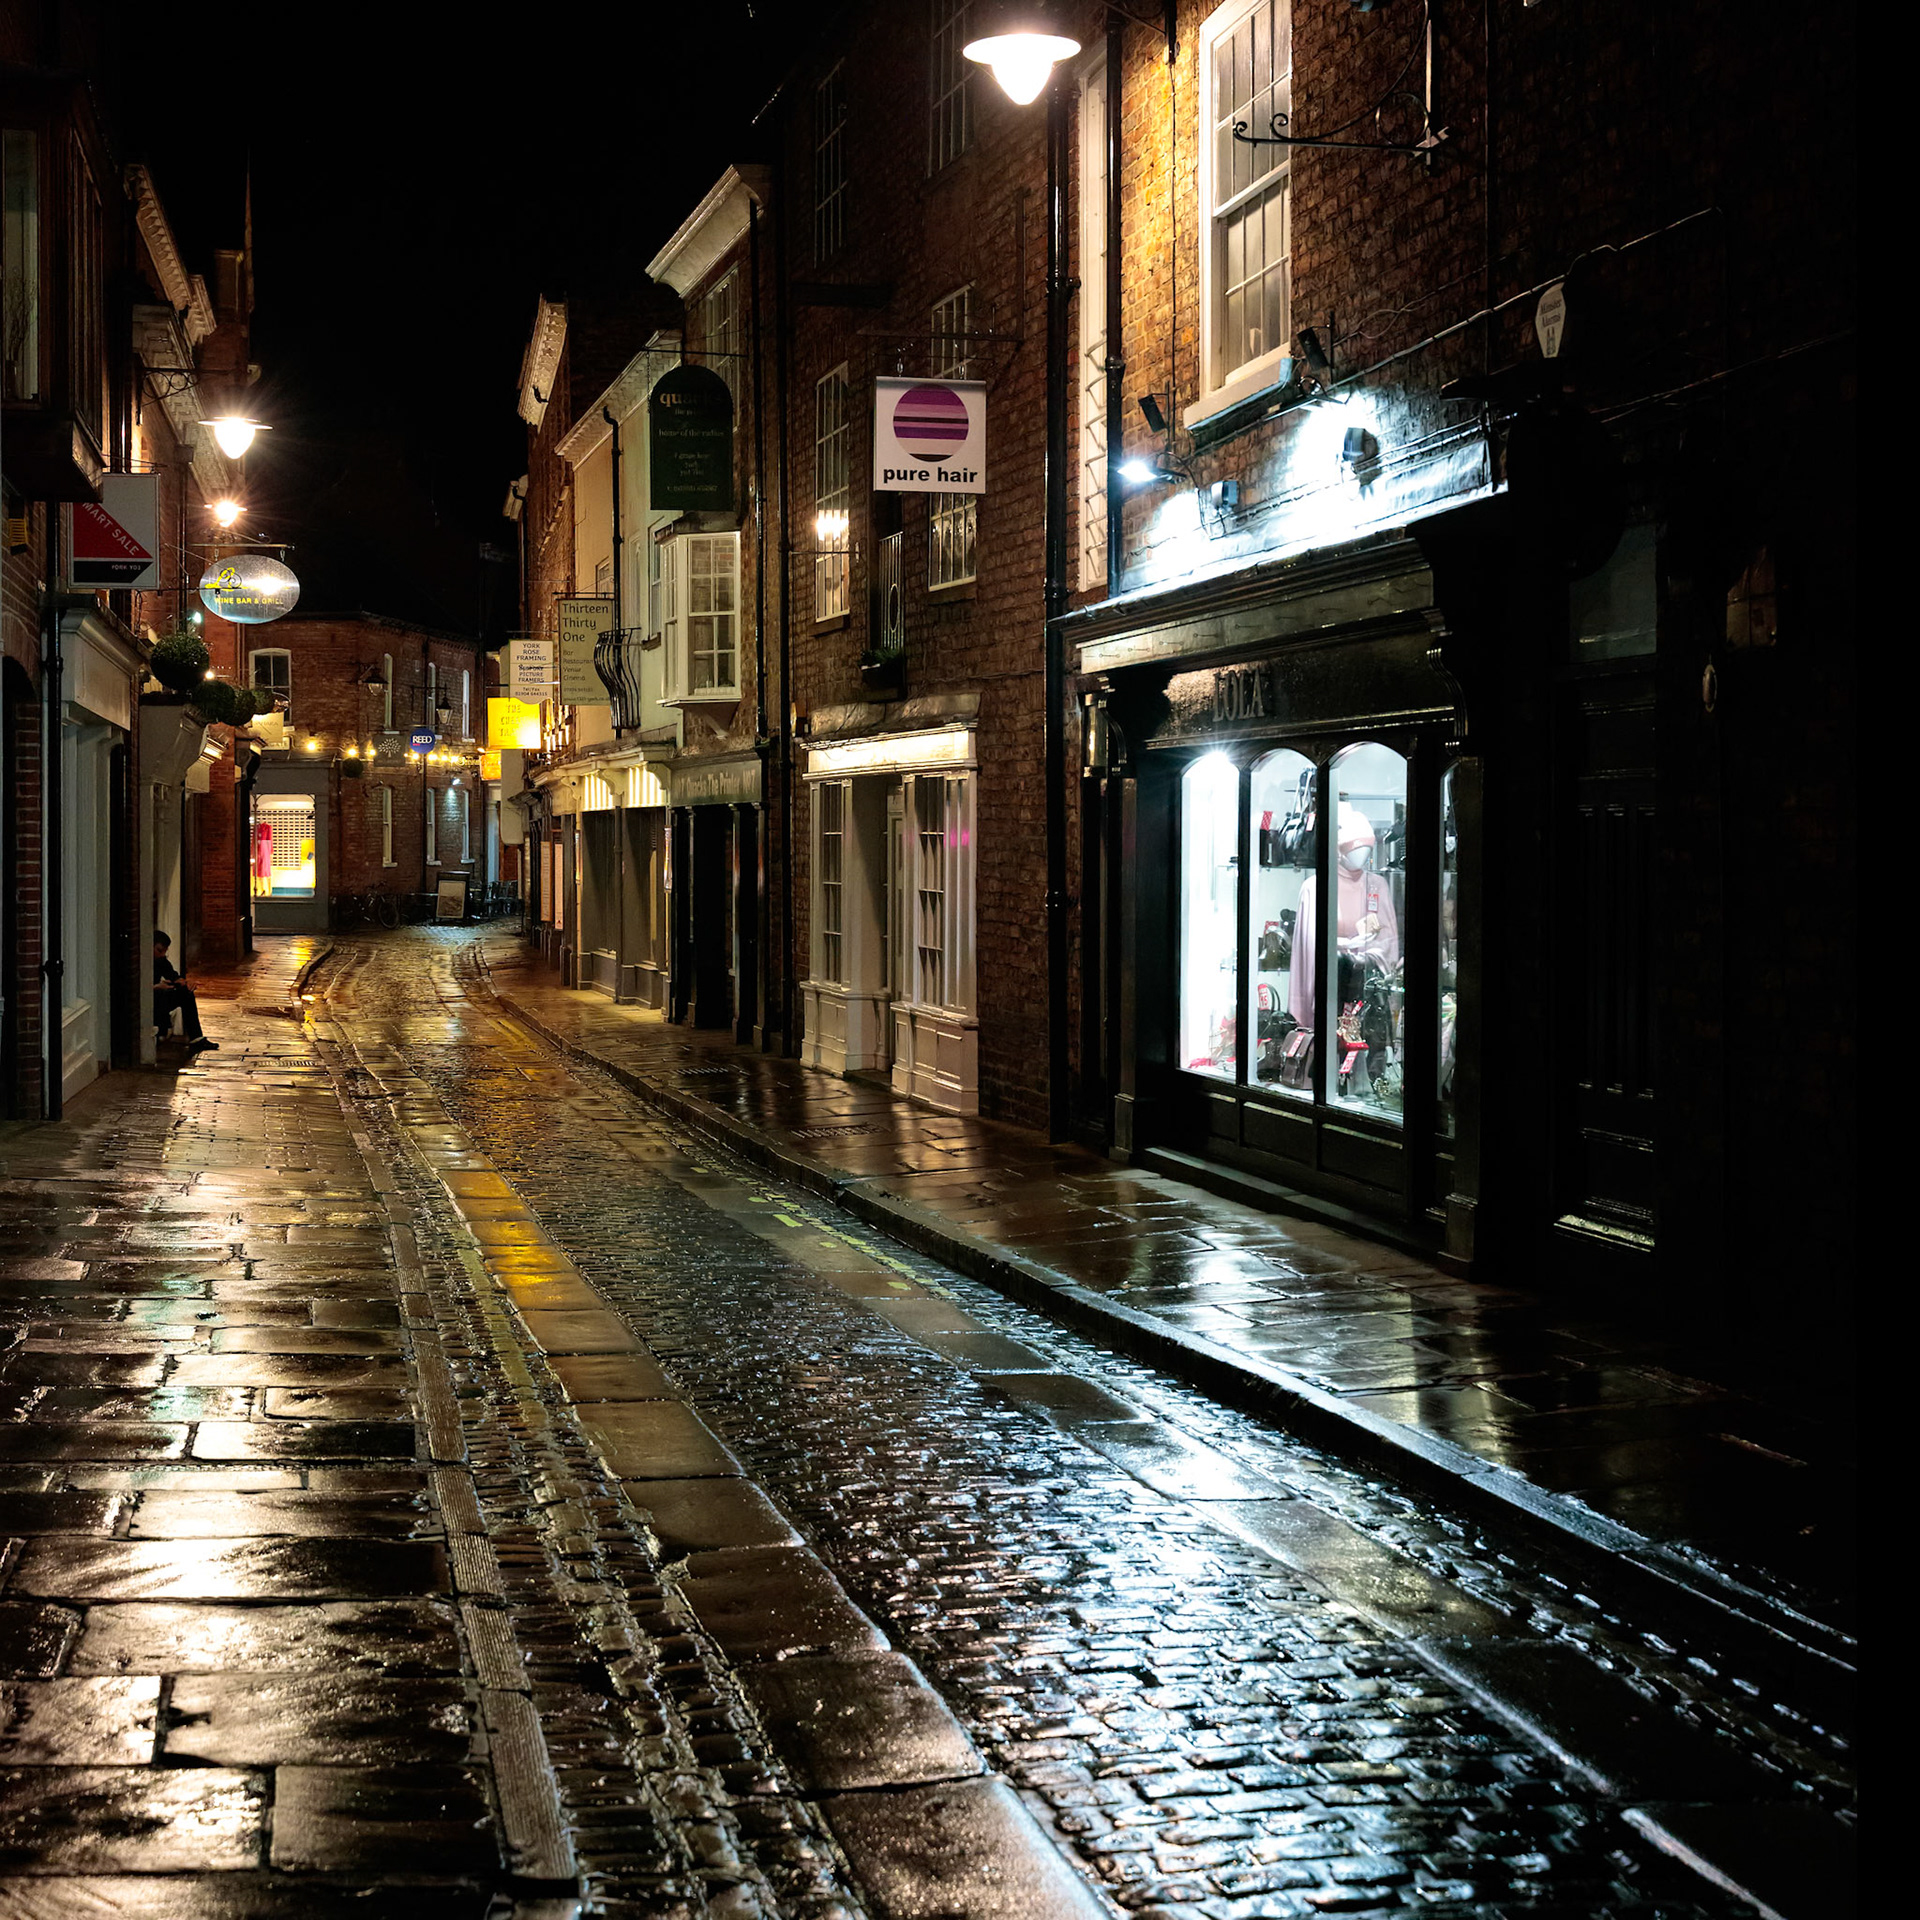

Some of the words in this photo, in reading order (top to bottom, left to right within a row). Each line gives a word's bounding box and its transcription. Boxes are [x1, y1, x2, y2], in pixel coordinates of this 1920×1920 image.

[883, 468, 930, 484] pure
[937, 467, 978, 482] hair
[111, 528, 140, 556] SALE
[214, 597, 234, 605] WINE
[236, 597, 252, 605] BAR
[261, 597, 284, 605] GRILL
[562, 603, 609, 614] Thirteen
[562, 617, 597, 631] Thirty
[562, 632, 585, 642] One
[1212, 668, 1266, 722] LOLA
[412, 735, 432, 744] REED
[708, 773, 719, 796] The
